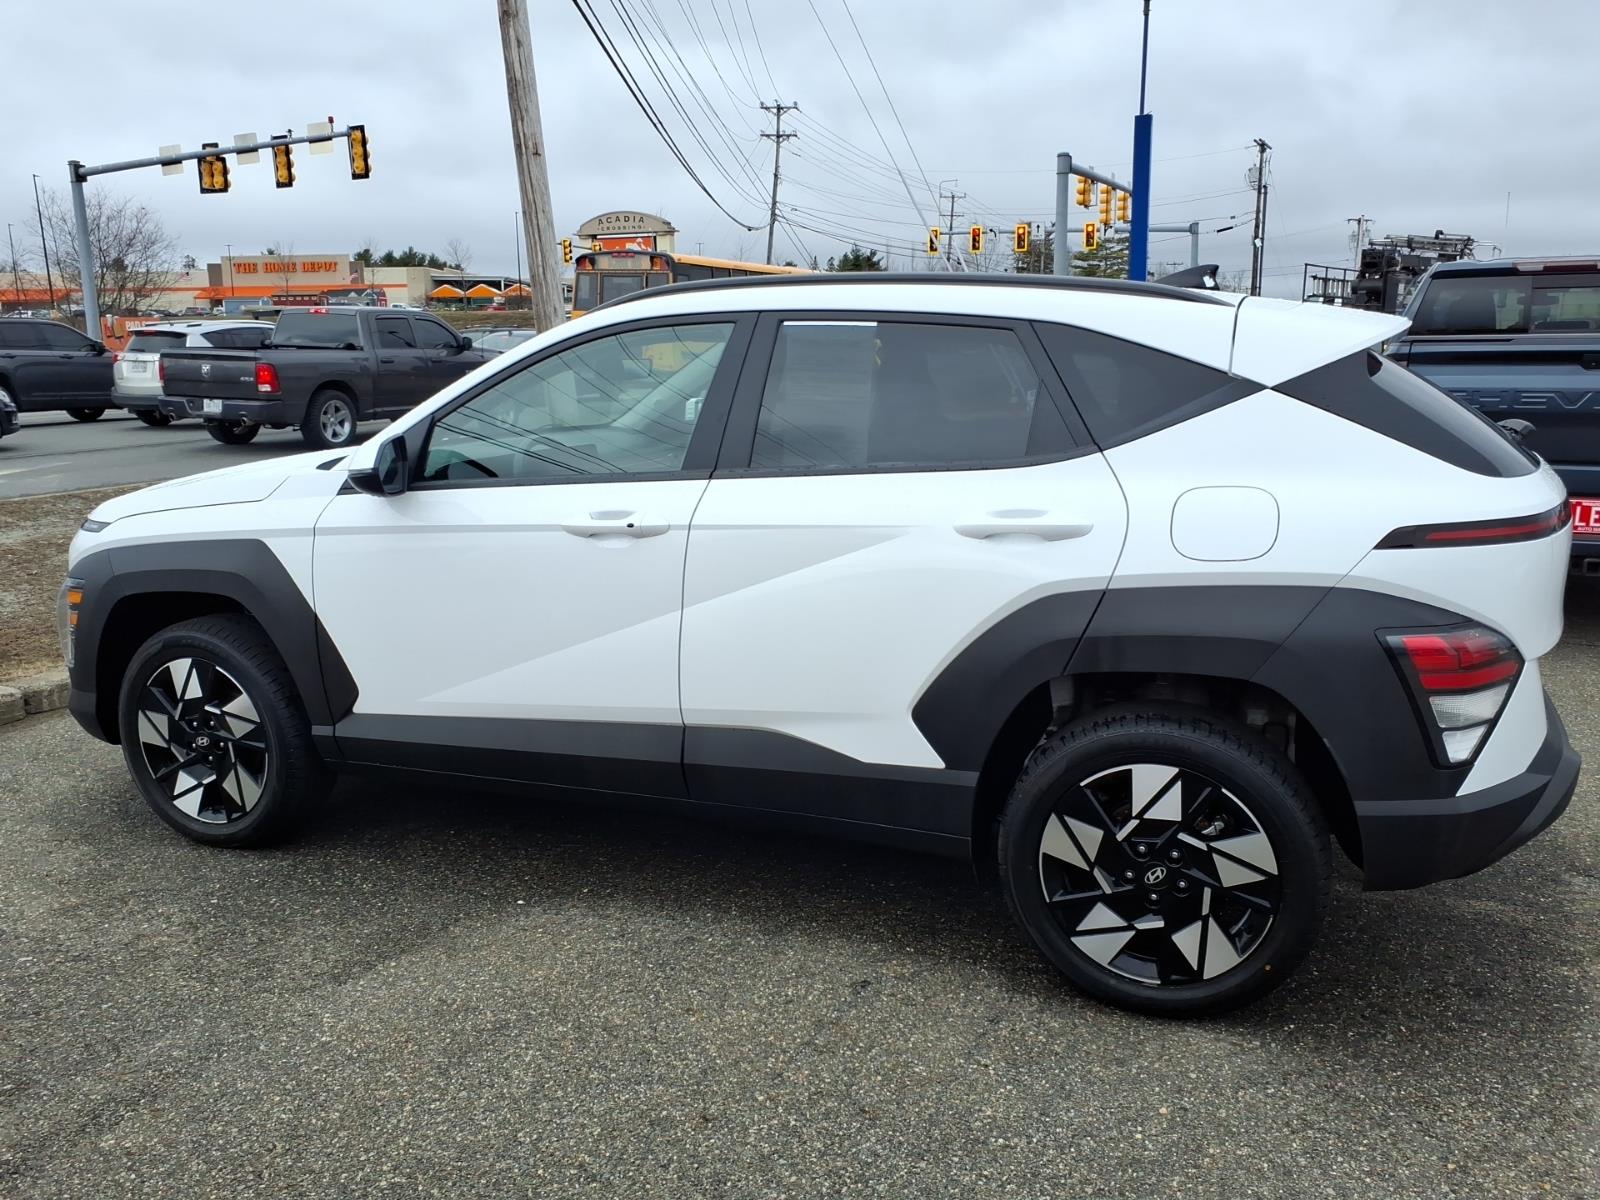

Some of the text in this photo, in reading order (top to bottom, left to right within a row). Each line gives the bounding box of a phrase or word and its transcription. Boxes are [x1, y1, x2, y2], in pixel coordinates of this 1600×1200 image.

[598, 216, 645, 226] ACADIA
[233, 262, 258, 273] THE
[302, 261, 338, 273] DEPOT
